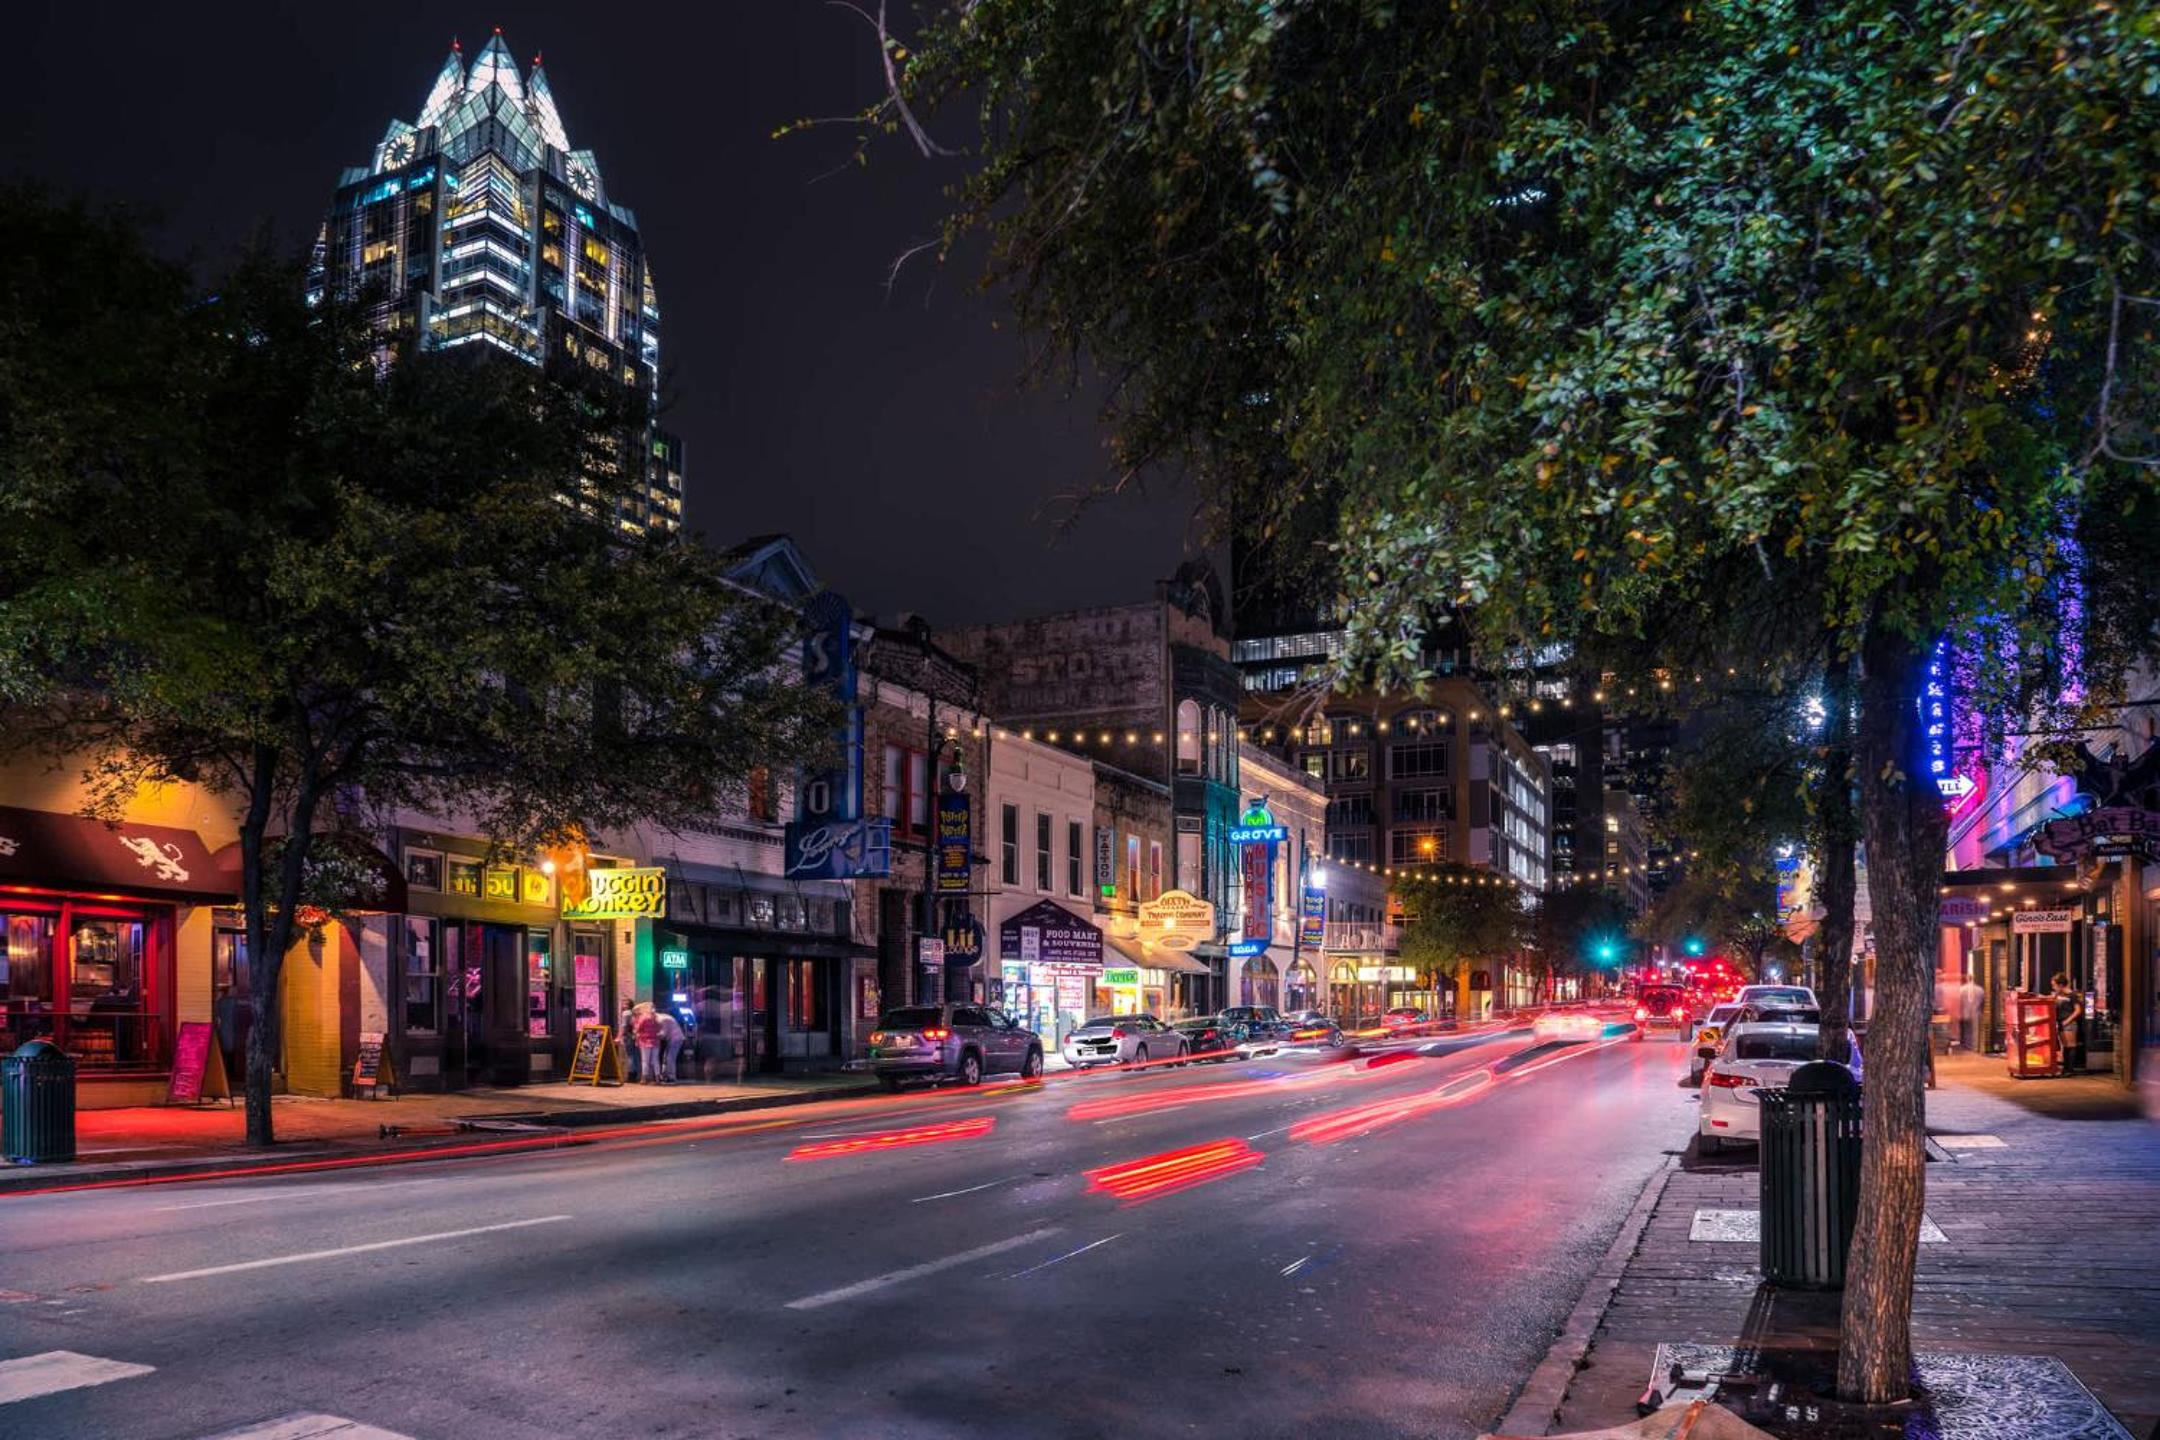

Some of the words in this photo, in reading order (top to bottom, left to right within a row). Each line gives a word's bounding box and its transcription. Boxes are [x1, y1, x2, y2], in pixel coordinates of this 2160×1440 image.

[2129, 811, 2160, 832] Ba
[1231, 829, 1283, 841] GROVE
[1099, 834, 1110, 878] TATTOO
[1940, 902, 1985, 916] ARISH
[1046, 930, 1071, 939] FOOD
[1073, 931, 1098, 941] MART
[666, 953, 685, 965] ATM
